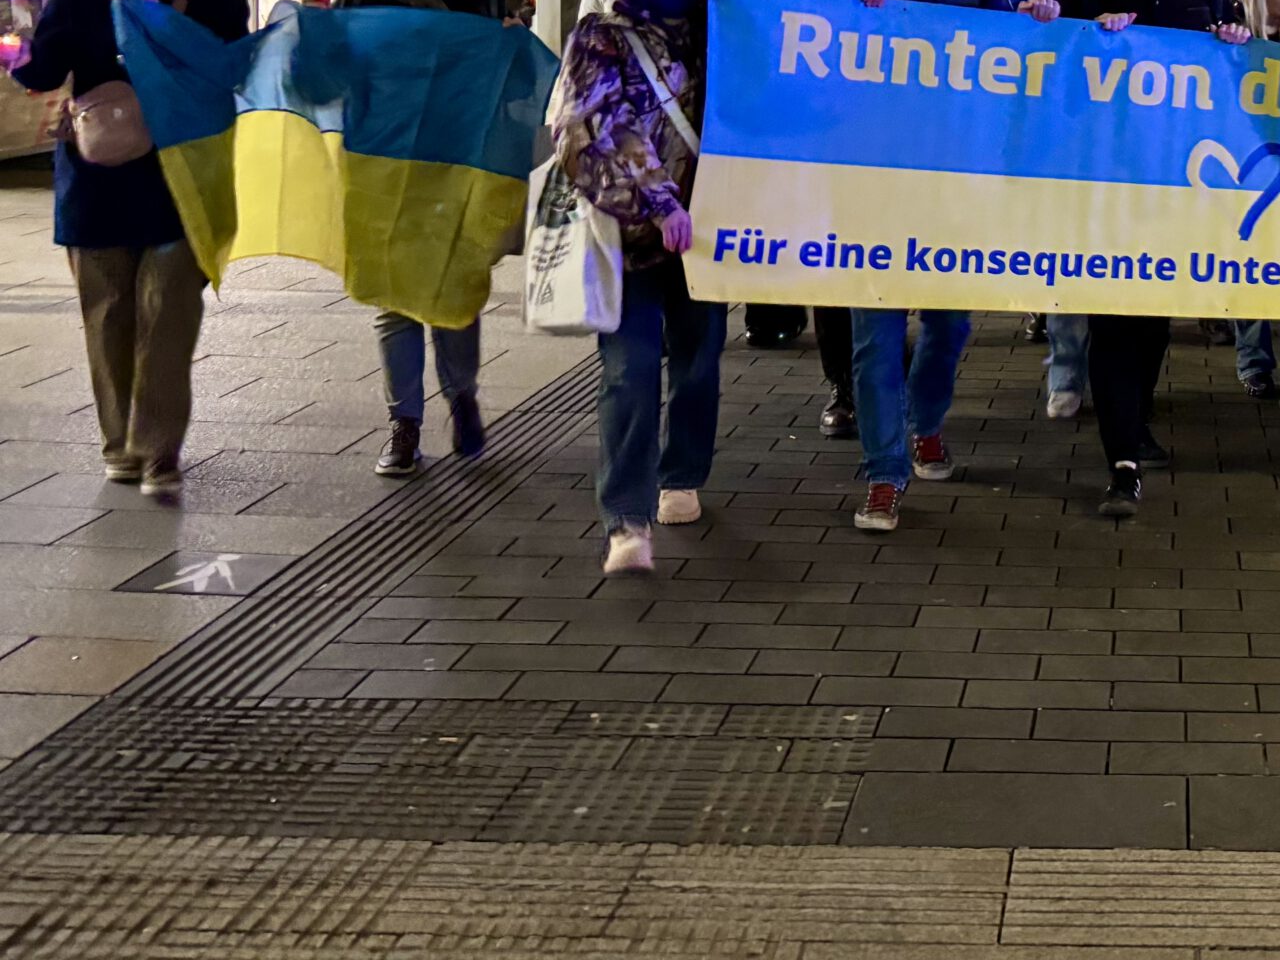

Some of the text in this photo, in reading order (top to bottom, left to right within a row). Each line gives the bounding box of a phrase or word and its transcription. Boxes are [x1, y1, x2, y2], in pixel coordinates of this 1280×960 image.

[778, 10, 1057, 97] Runter
[1082, 55, 1214, 110] von
[713, 227, 787, 265] Für
[799, 233, 893, 270] eine
[905, 237, 1178, 287] konsequente
